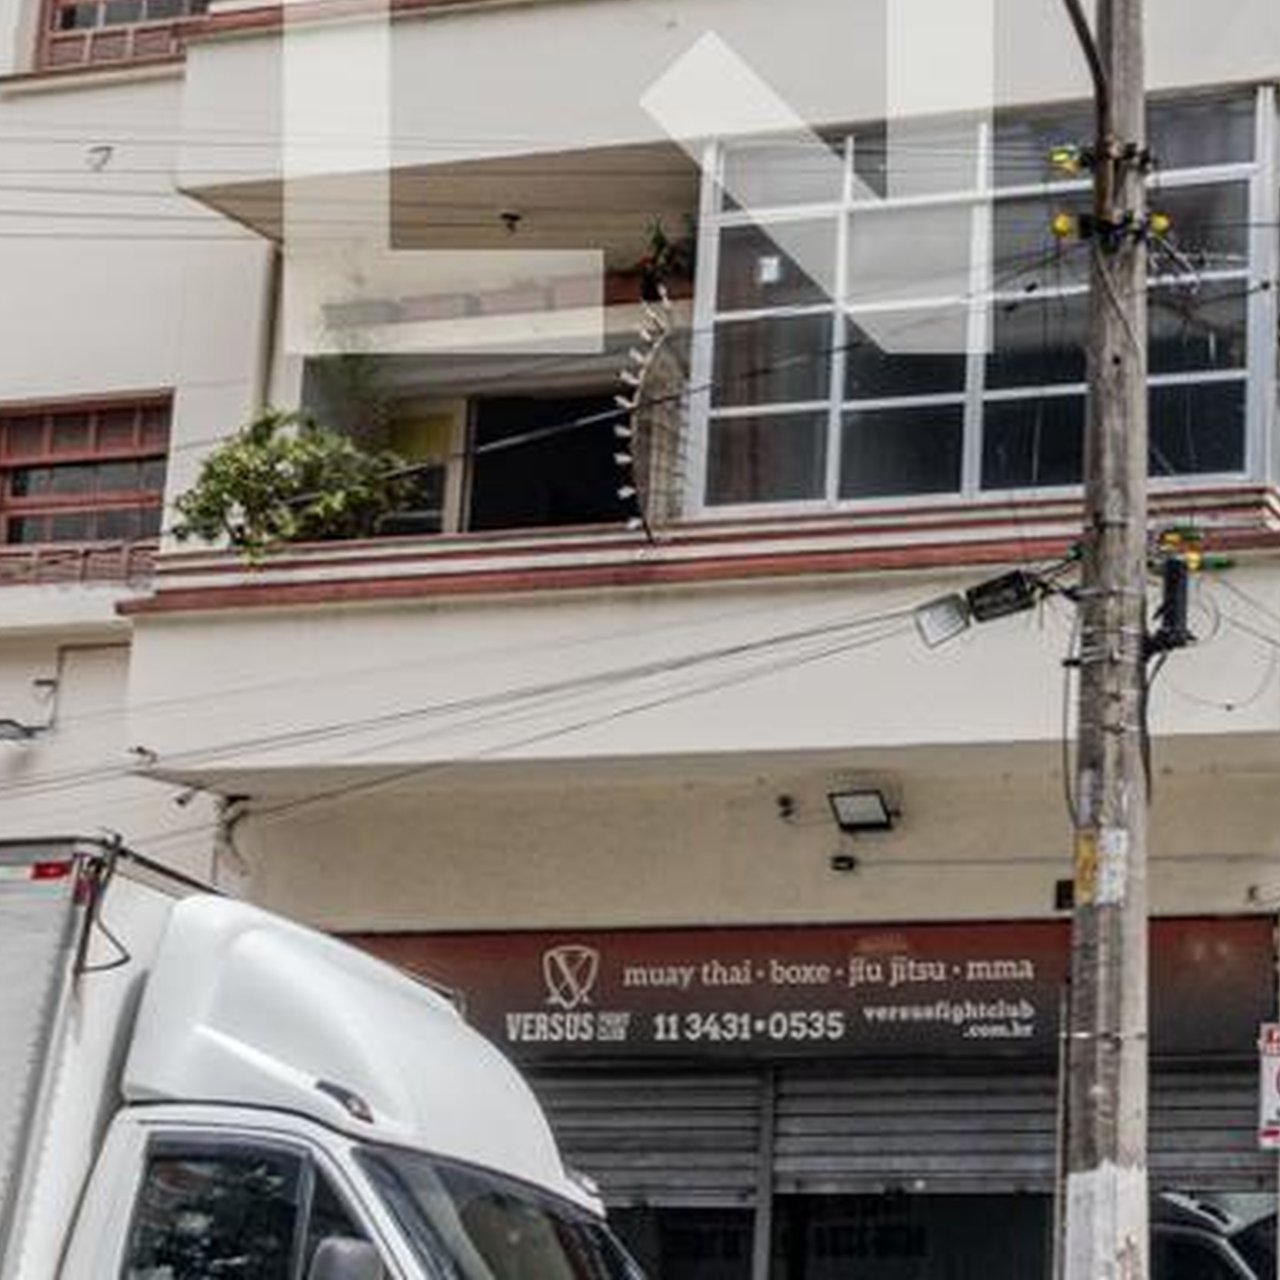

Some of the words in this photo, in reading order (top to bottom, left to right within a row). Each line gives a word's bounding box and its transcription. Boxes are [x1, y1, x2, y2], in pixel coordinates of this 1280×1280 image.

[622, 964, 695, 991] muay
[701, 959, 752, 985] thai
[770, 959, 833, 985] boxe
[888, 956, 947, 988] jitsu
[965, 959, 1035, 981] mma
[505, 1012, 594, 1041] VERSUS
[653, 1013, 680, 1041] 11
